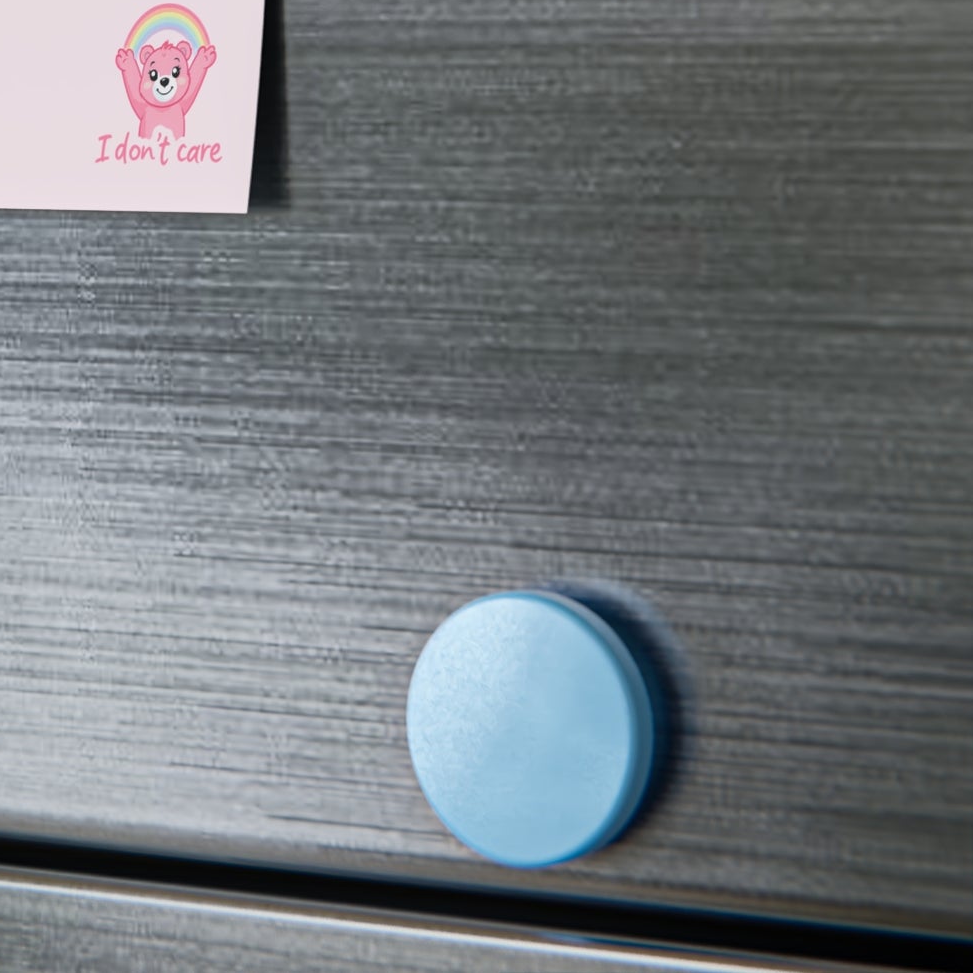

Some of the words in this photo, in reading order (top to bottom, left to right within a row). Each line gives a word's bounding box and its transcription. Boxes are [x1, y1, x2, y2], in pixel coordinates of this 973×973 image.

[96, 134, 113, 163] I
[115, 132, 170, 165] don't
[177, 142, 223, 164] care
